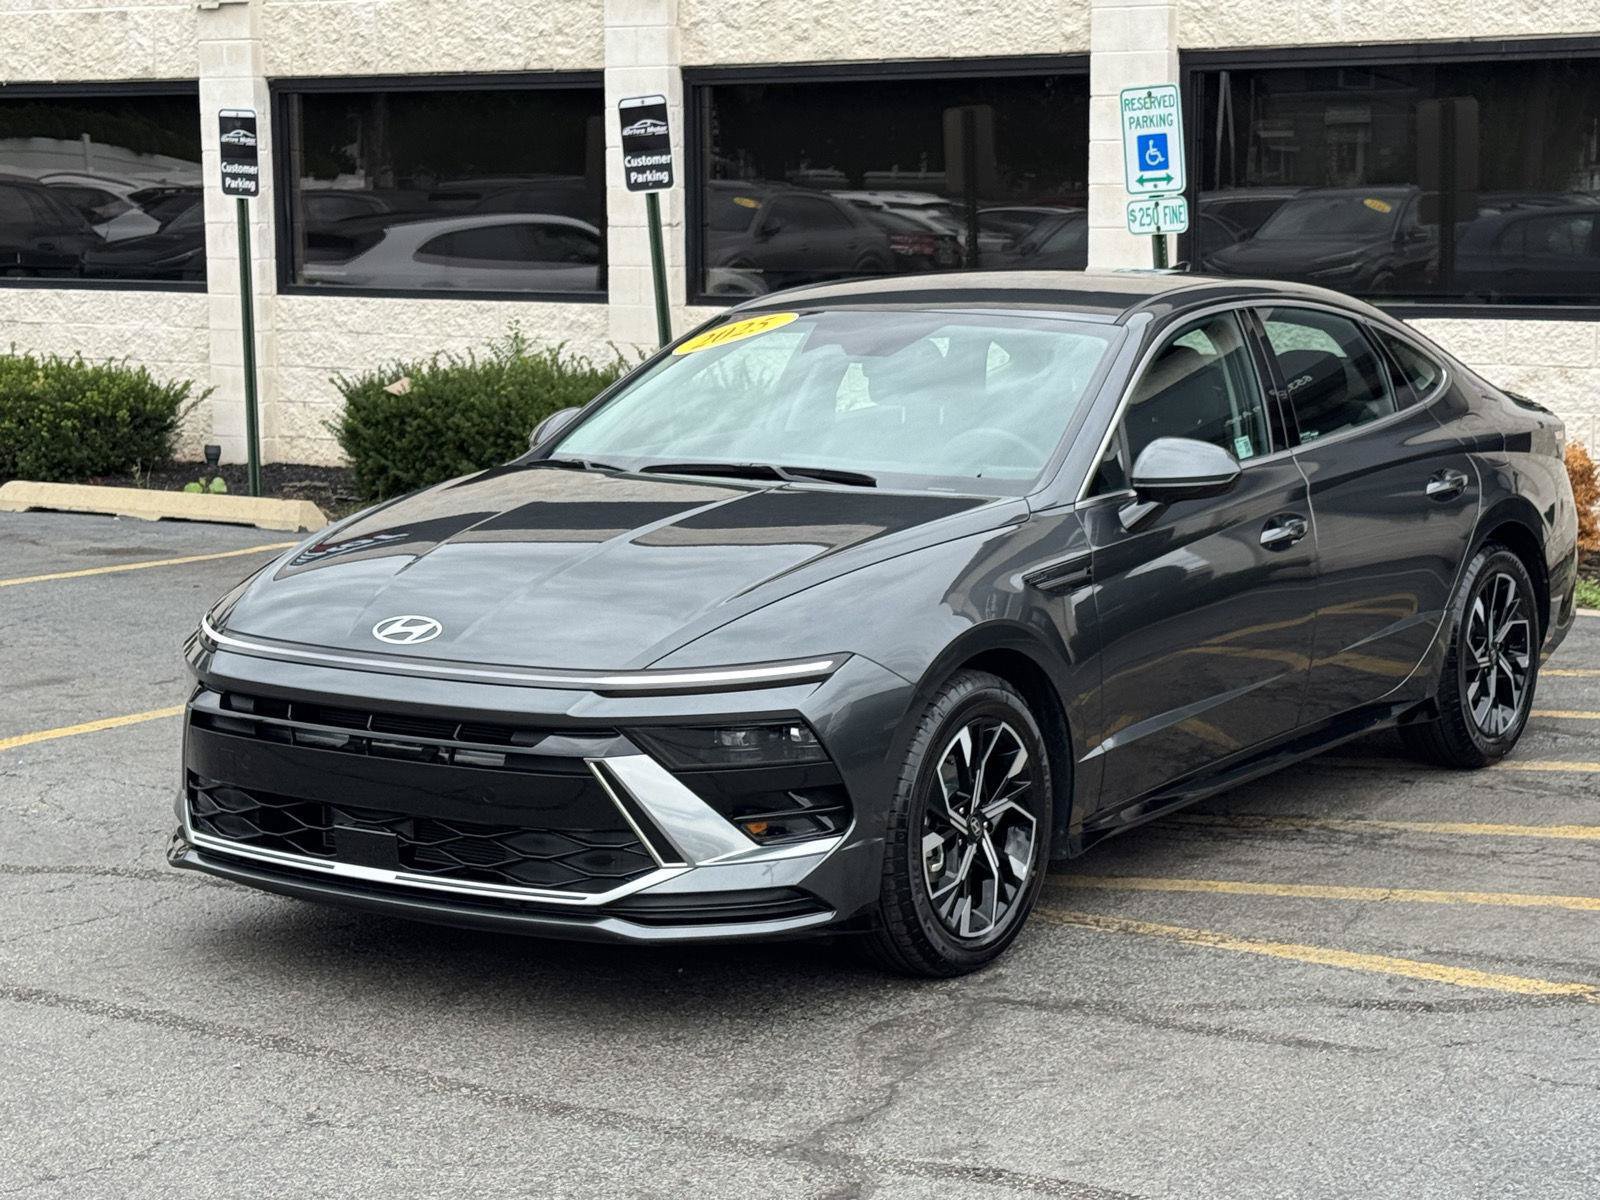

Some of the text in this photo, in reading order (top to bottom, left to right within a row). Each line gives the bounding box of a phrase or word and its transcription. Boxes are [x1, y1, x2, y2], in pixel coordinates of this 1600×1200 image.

[1124, 95, 1175, 112] RESERVED
[1128, 113, 1173, 130] PARKING
[221, 161, 258, 175] Customer
[625, 154, 672, 168] Customer
[225, 176, 256, 192] Parking
[630, 169, 669, 184] Parking
[1163, 204, 1186, 225] FINE
[691, 316, 778, 350] 2025
